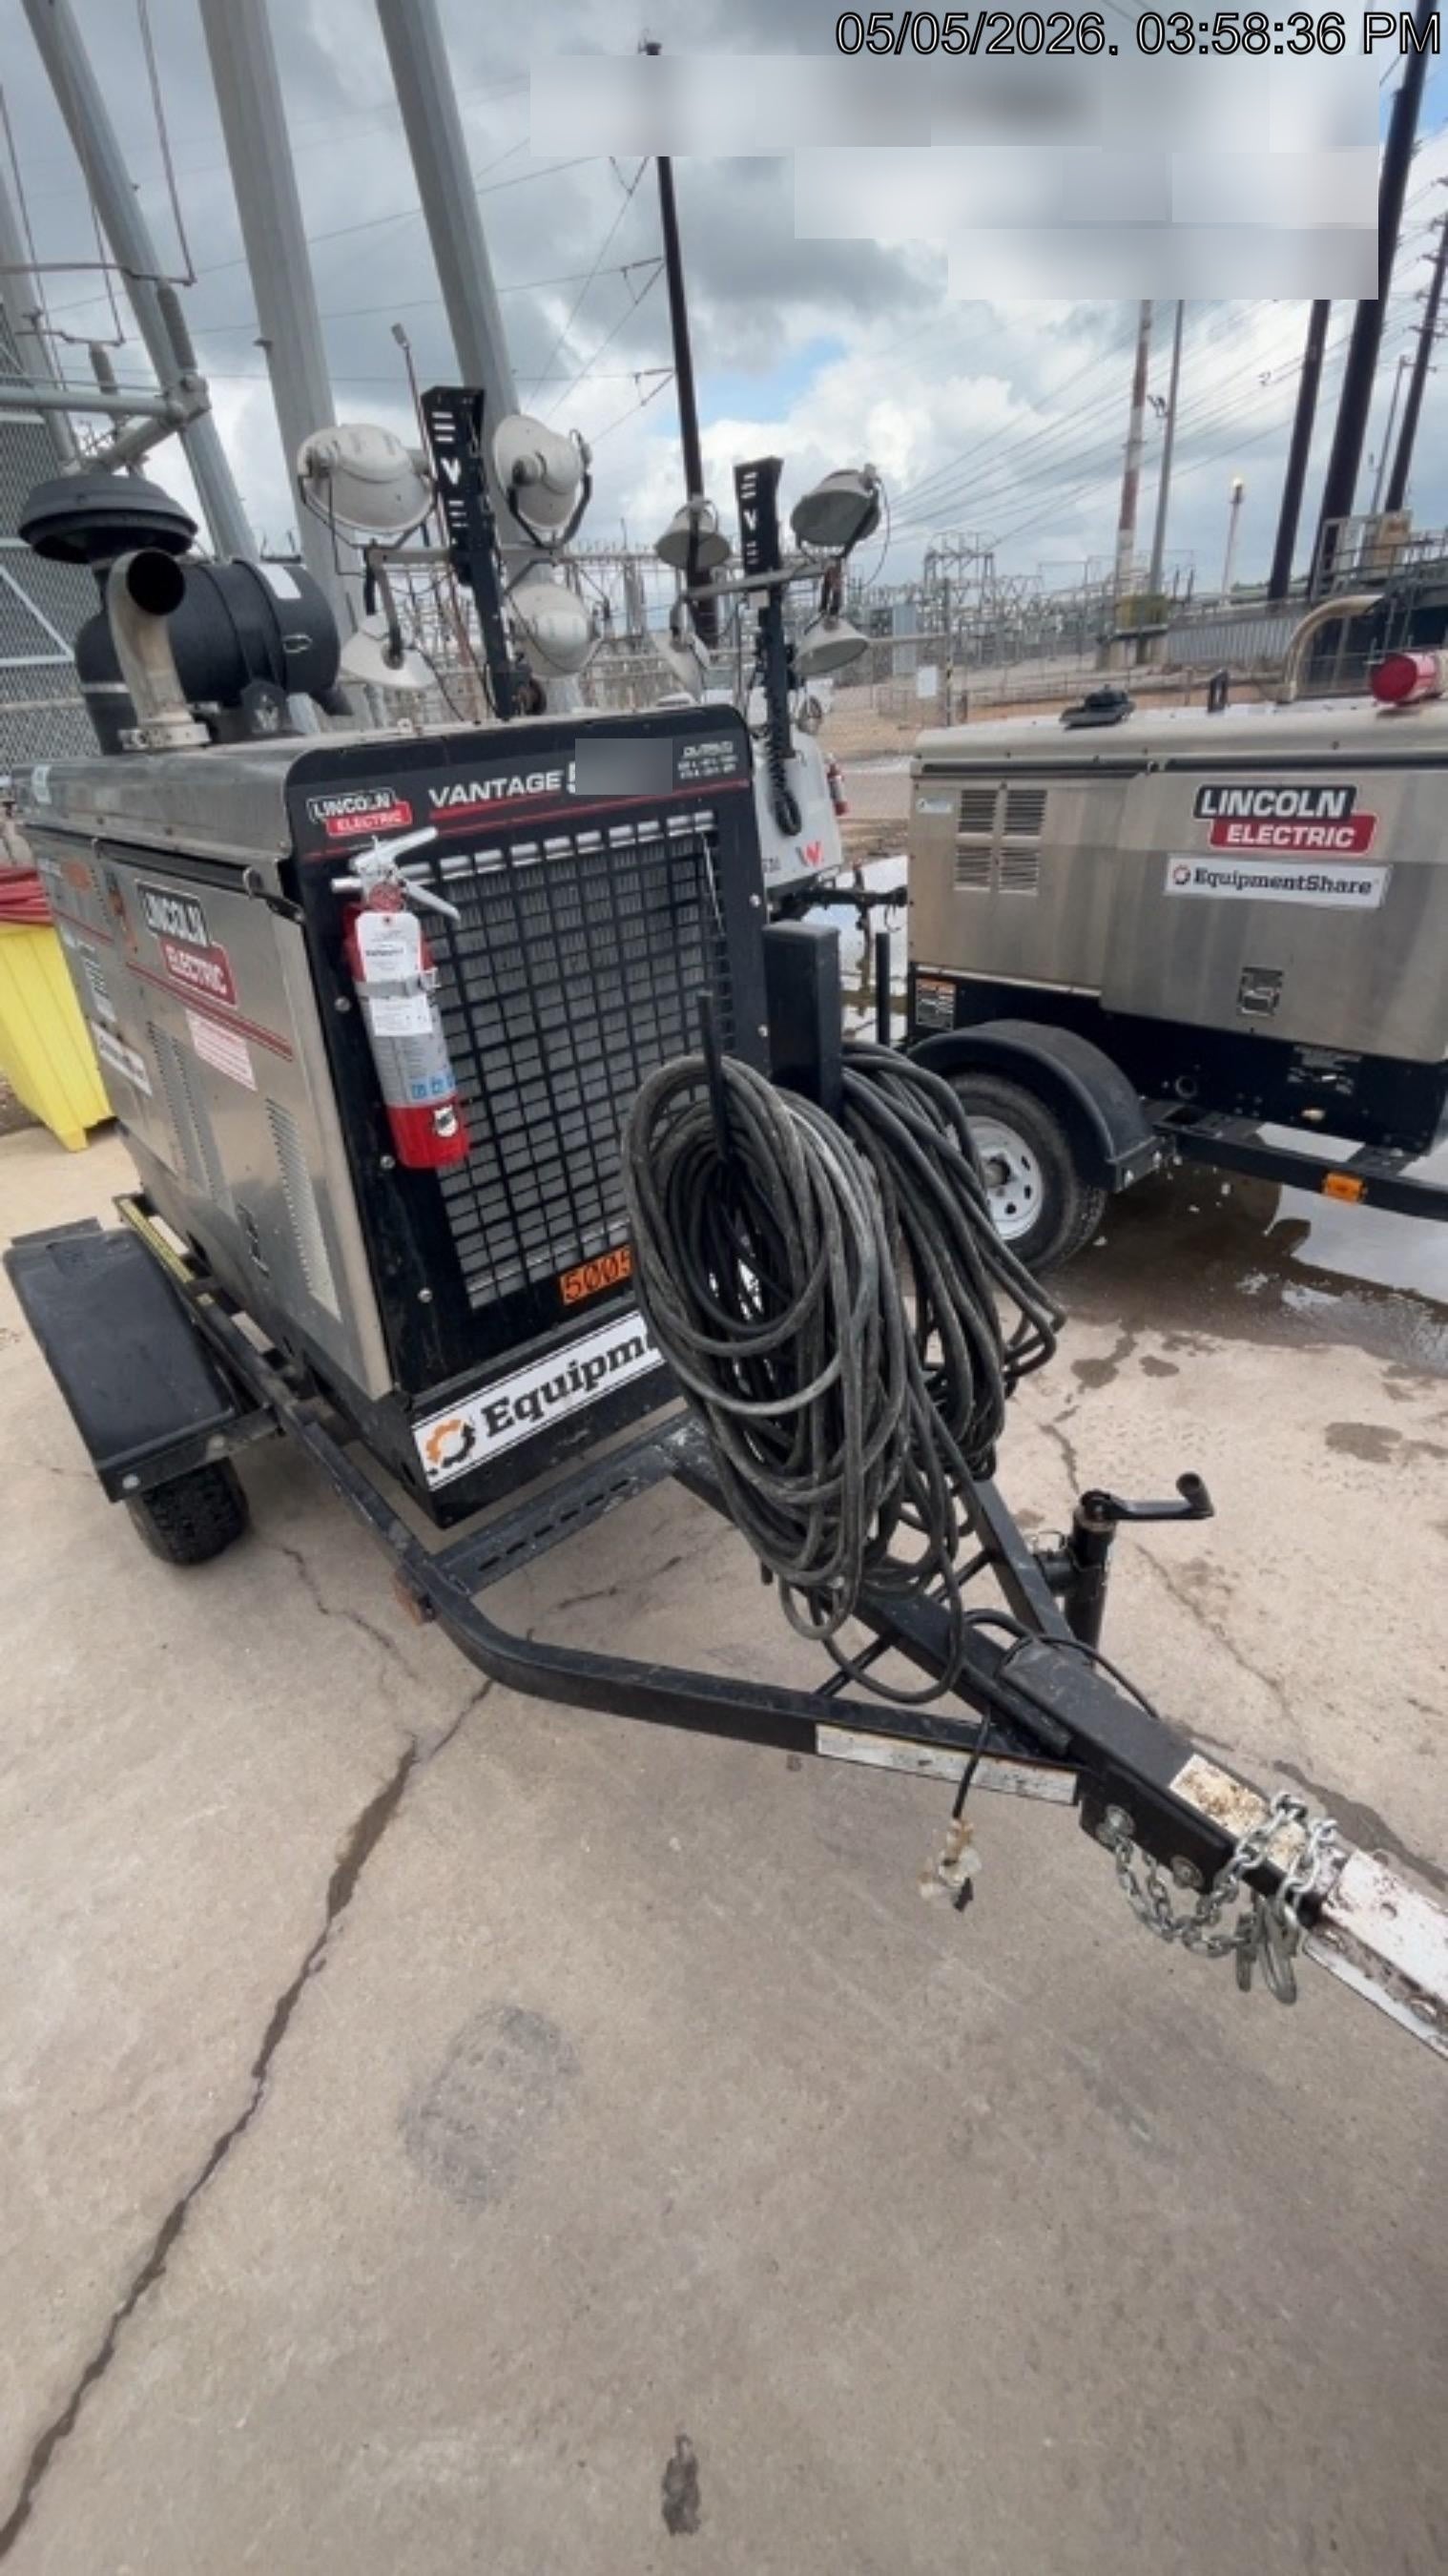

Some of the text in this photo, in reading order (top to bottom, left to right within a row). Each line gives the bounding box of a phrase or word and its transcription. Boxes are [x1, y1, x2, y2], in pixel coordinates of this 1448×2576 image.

[429, 770, 564, 808] VANTAGE
[313, 792, 392, 817] LINCOLN
[1200, 789, 1347, 817] LINCOLN
[337, 811, 403, 832] ELECTRIC
[1227, 823, 1355, 848] ELECTRIC
[1193, 866, 1373, 894] EquipmentShare
